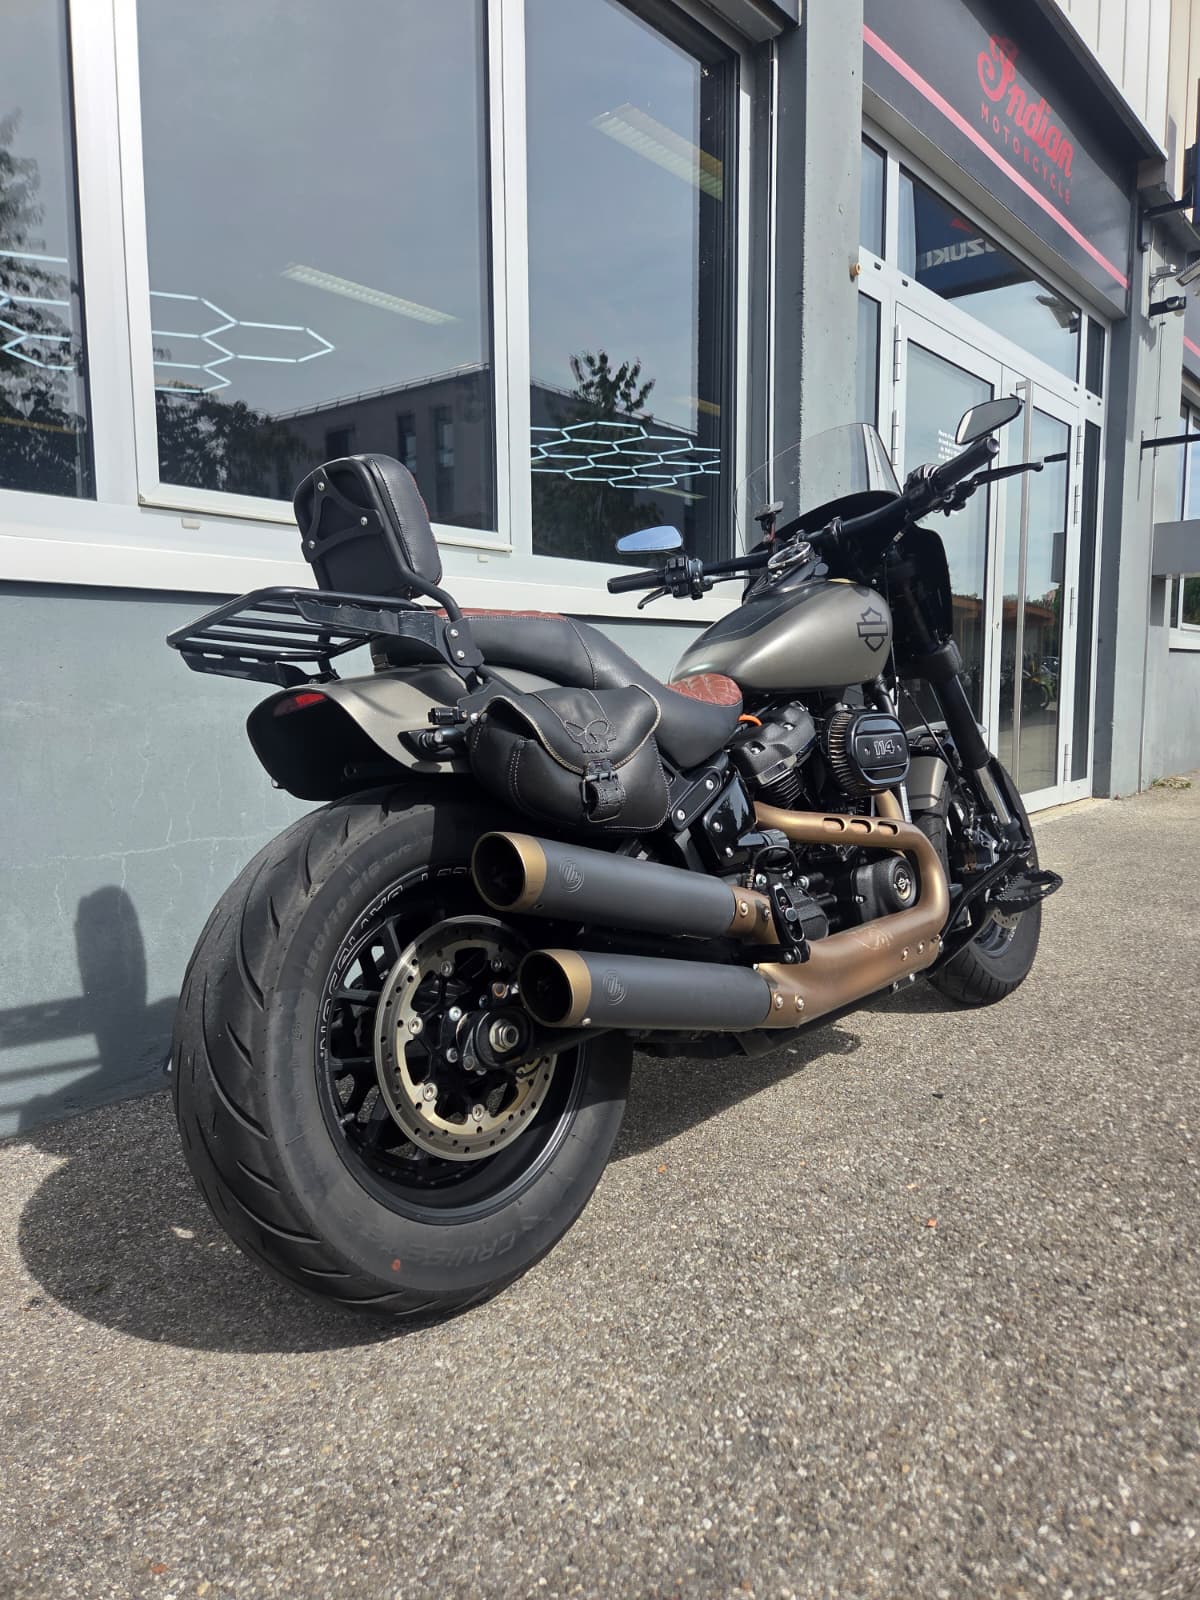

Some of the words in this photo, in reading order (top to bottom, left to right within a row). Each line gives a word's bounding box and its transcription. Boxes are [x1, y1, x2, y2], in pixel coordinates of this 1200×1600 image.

[977, 34, 1074, 178] Indian
[980, 101, 1071, 205] MOTORCYCLE
[873, 739, 896, 757] 114
